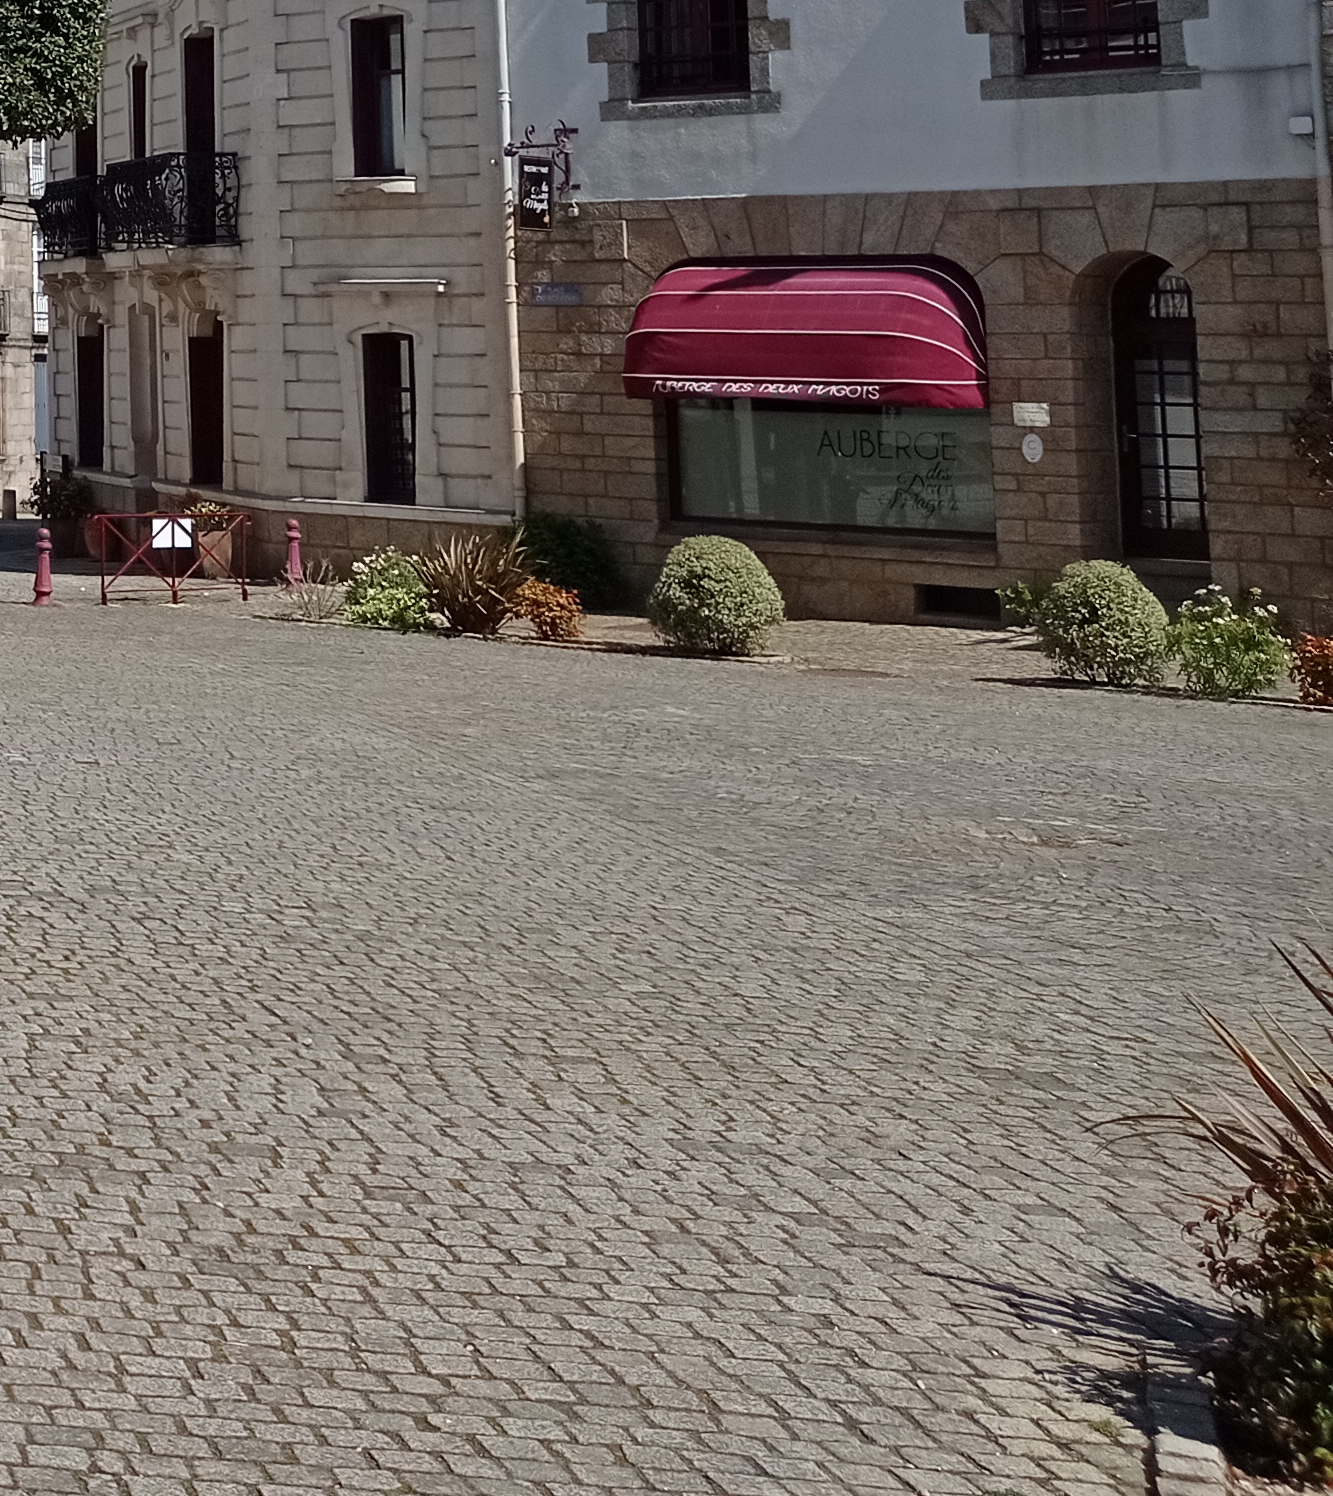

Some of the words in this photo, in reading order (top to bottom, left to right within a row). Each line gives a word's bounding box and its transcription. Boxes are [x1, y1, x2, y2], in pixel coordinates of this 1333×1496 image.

[652, 379, 718, 394] AUBERGE
[721, 381, 754, 393] DES
[758, 382, 804, 395] DEUX
[807, 383, 881, 400] MAGOTS
[817, 429, 958, 461] AUBERGE
